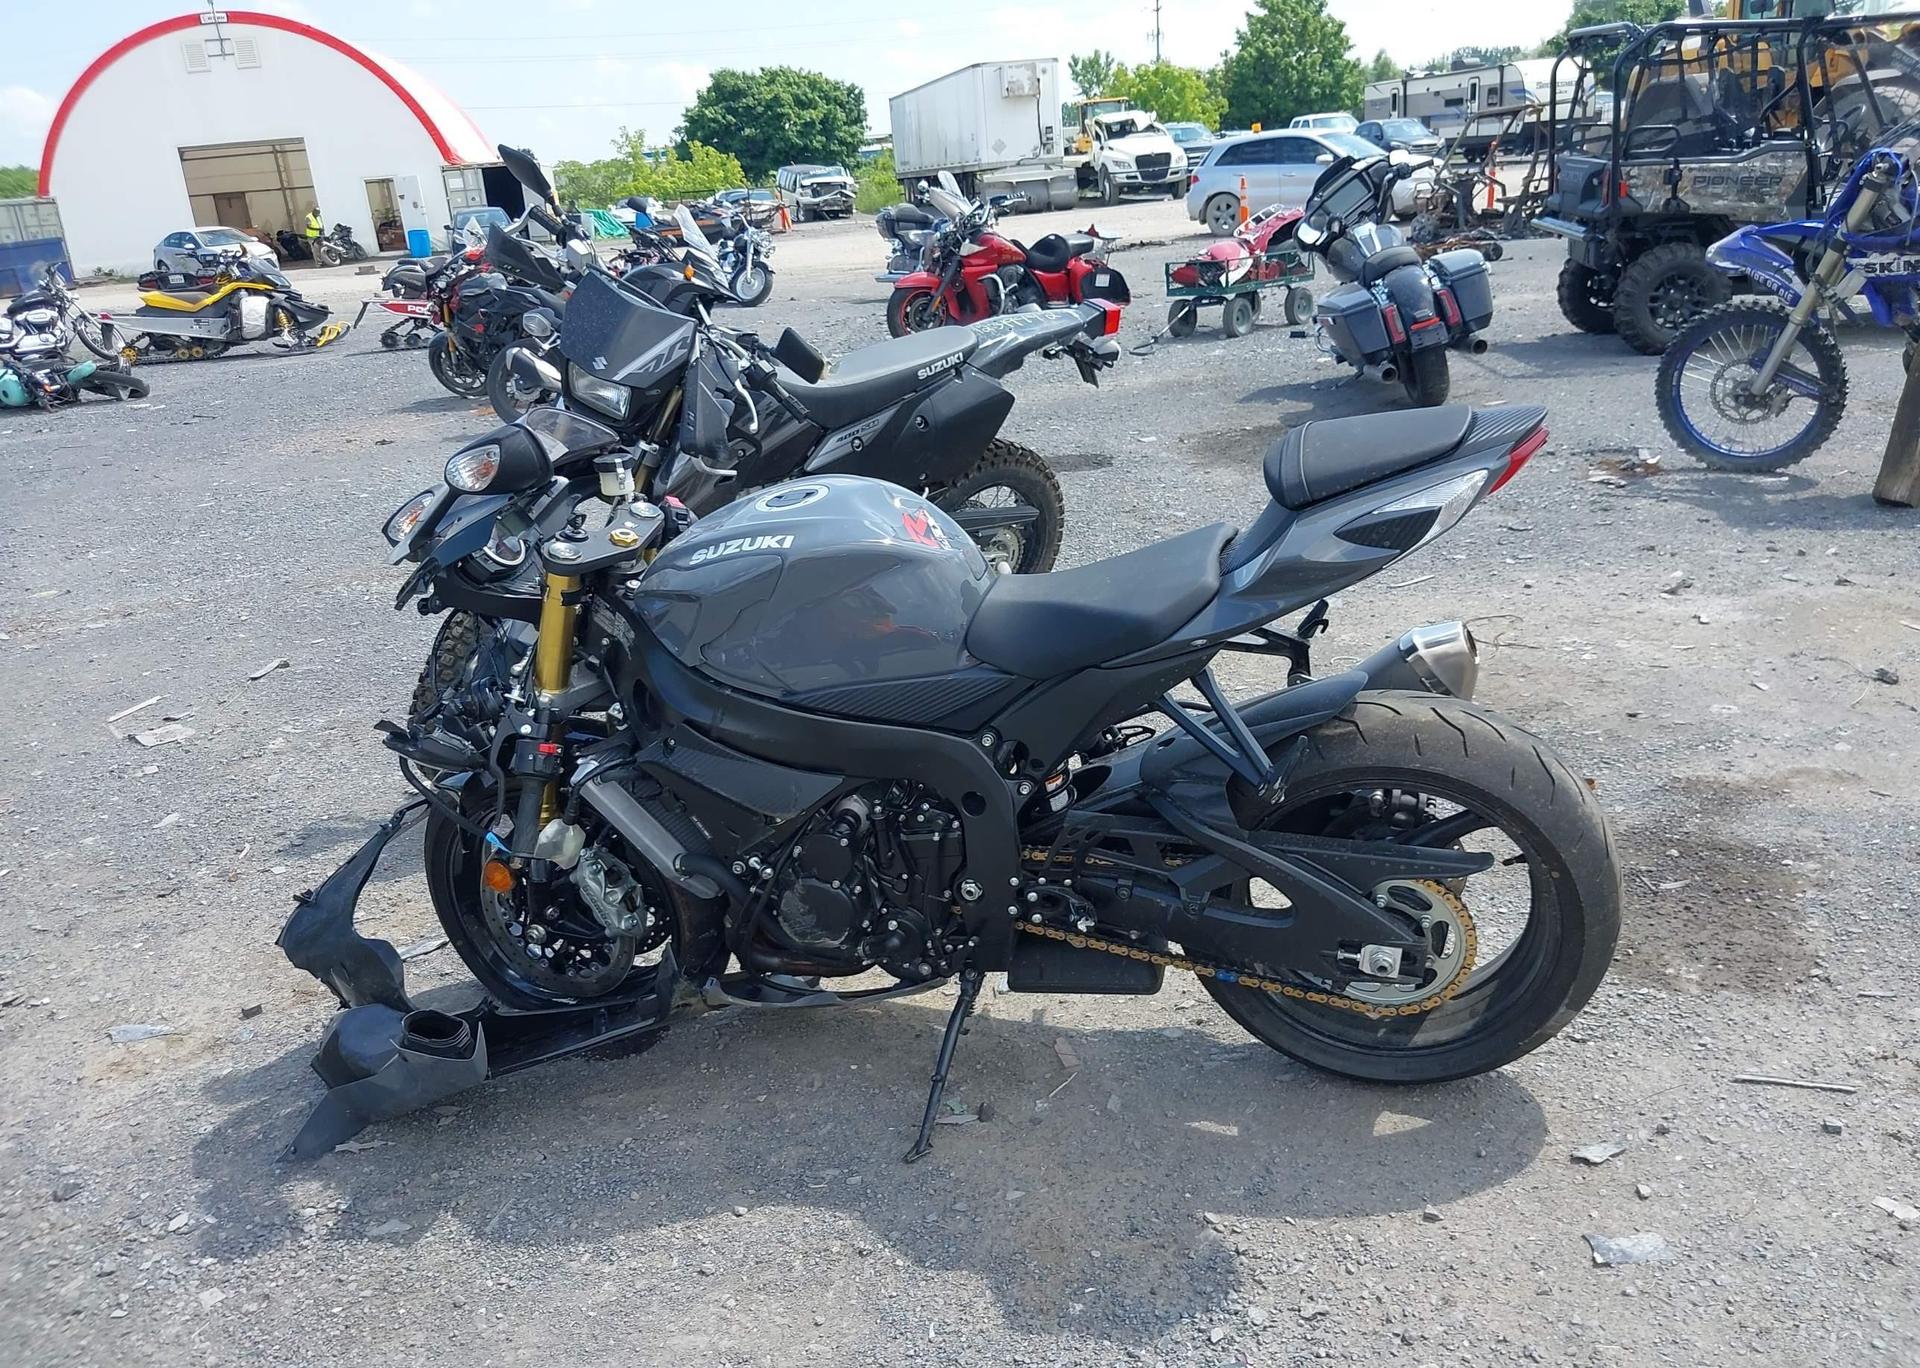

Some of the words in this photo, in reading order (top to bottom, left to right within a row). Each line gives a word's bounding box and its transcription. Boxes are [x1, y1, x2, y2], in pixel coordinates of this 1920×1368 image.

[1692, 175, 1782, 187] PIONEER
[917, 352, 964, 380] SUZUKI
[689, 535, 795, 566] SUZUKI
